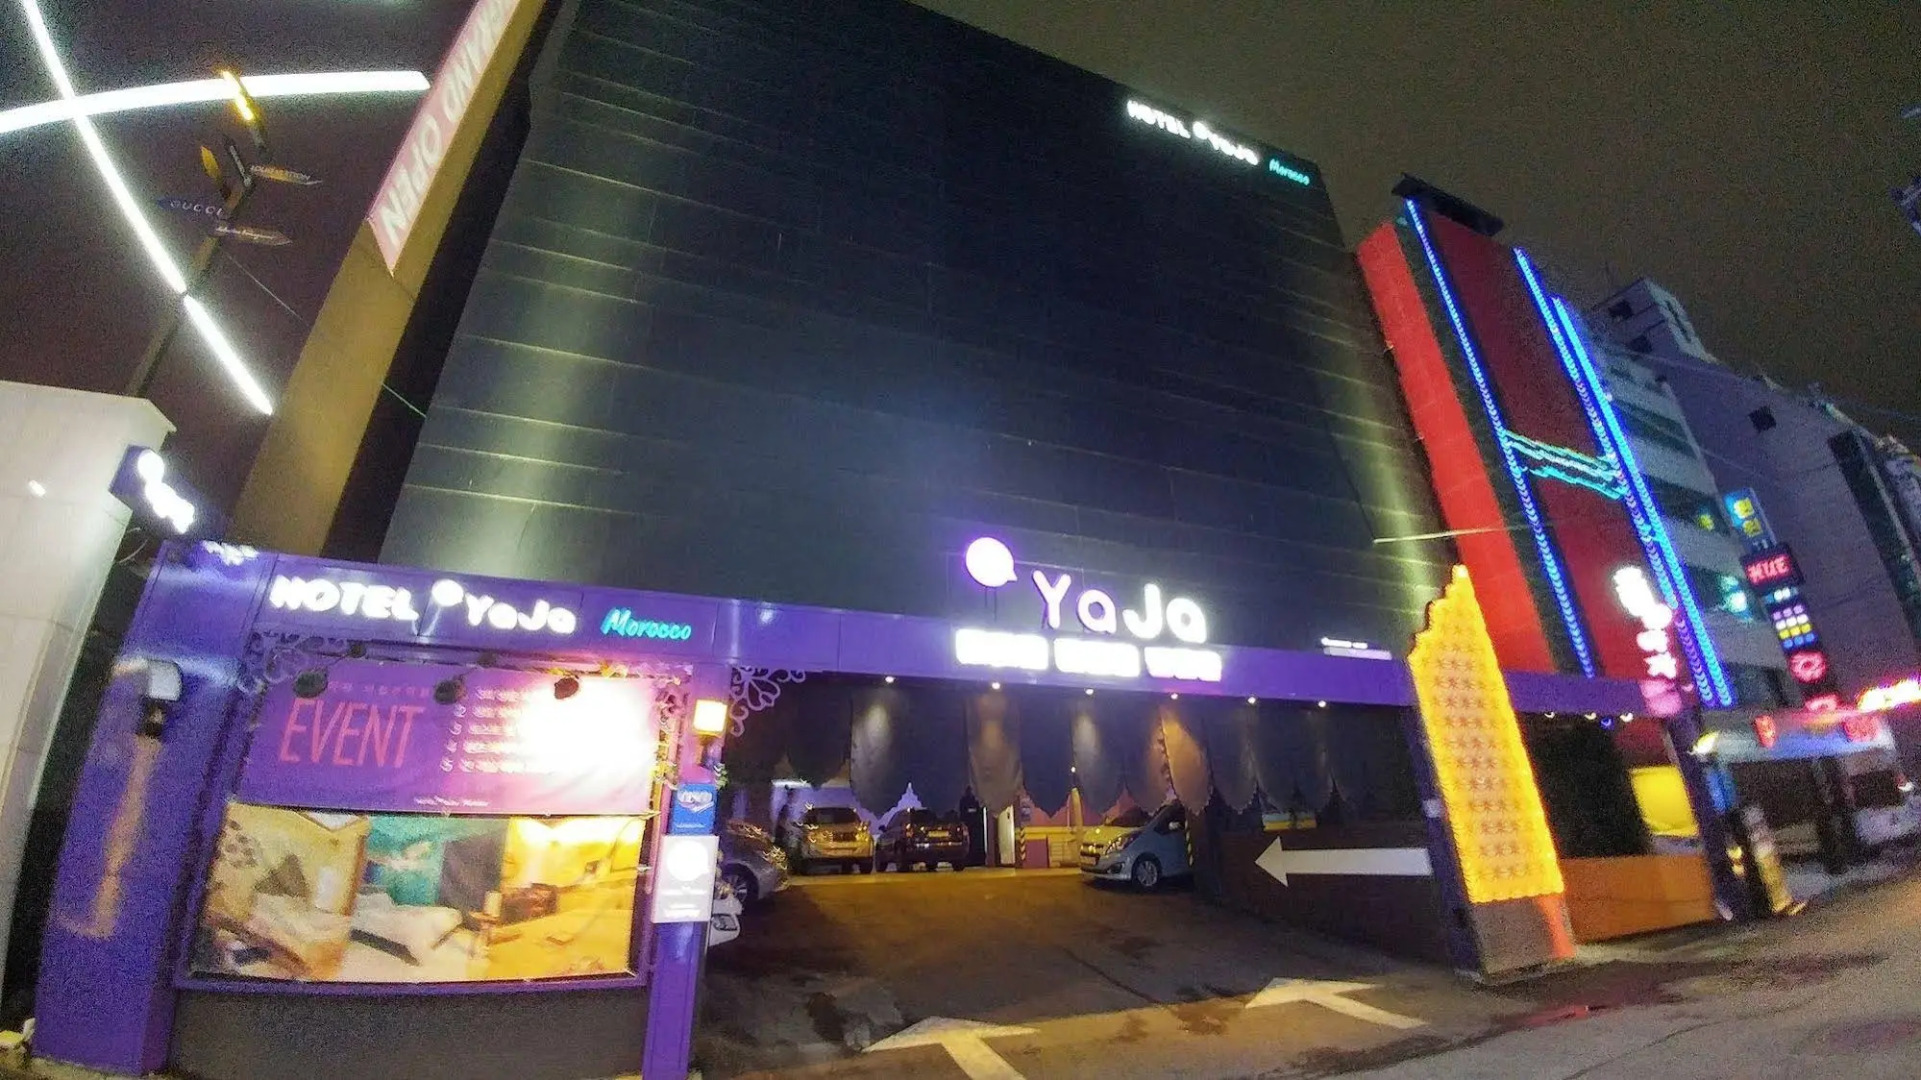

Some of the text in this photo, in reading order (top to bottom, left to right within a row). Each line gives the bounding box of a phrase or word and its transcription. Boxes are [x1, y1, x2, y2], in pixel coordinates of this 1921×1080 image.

[379, 115, 443, 247] OPEN
[267, 573, 694, 642] HOTEL YaJa Morocco
[1031, 568, 1208, 644] YaJa
[279, 696, 426, 769] EVENT
